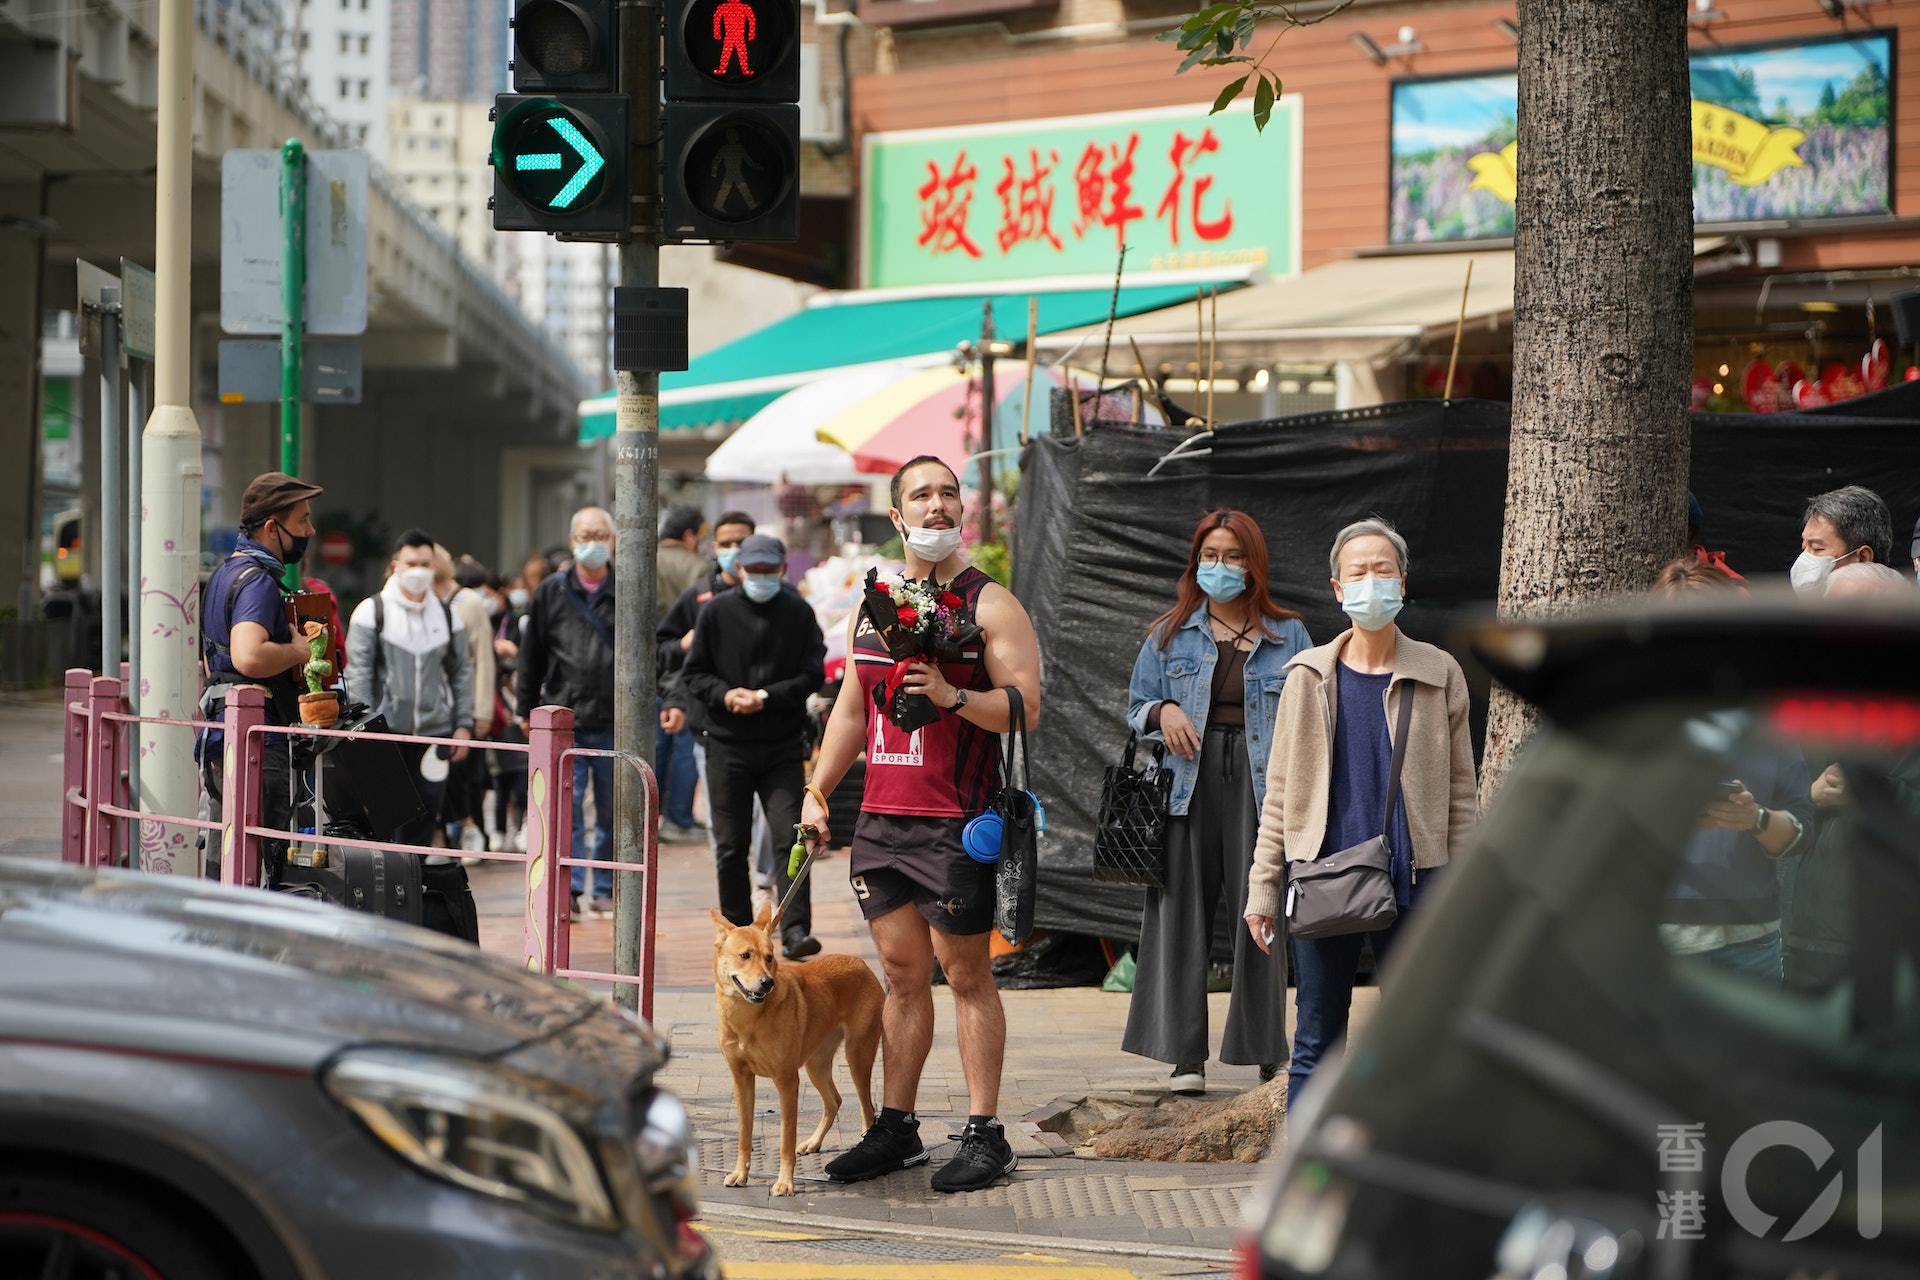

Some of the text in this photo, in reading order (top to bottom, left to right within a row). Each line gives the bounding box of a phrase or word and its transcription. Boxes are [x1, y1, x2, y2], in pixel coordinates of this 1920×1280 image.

[918, 127, 1233, 259] 竣誠鮮花
[873, 754, 920, 764] SPORTS
